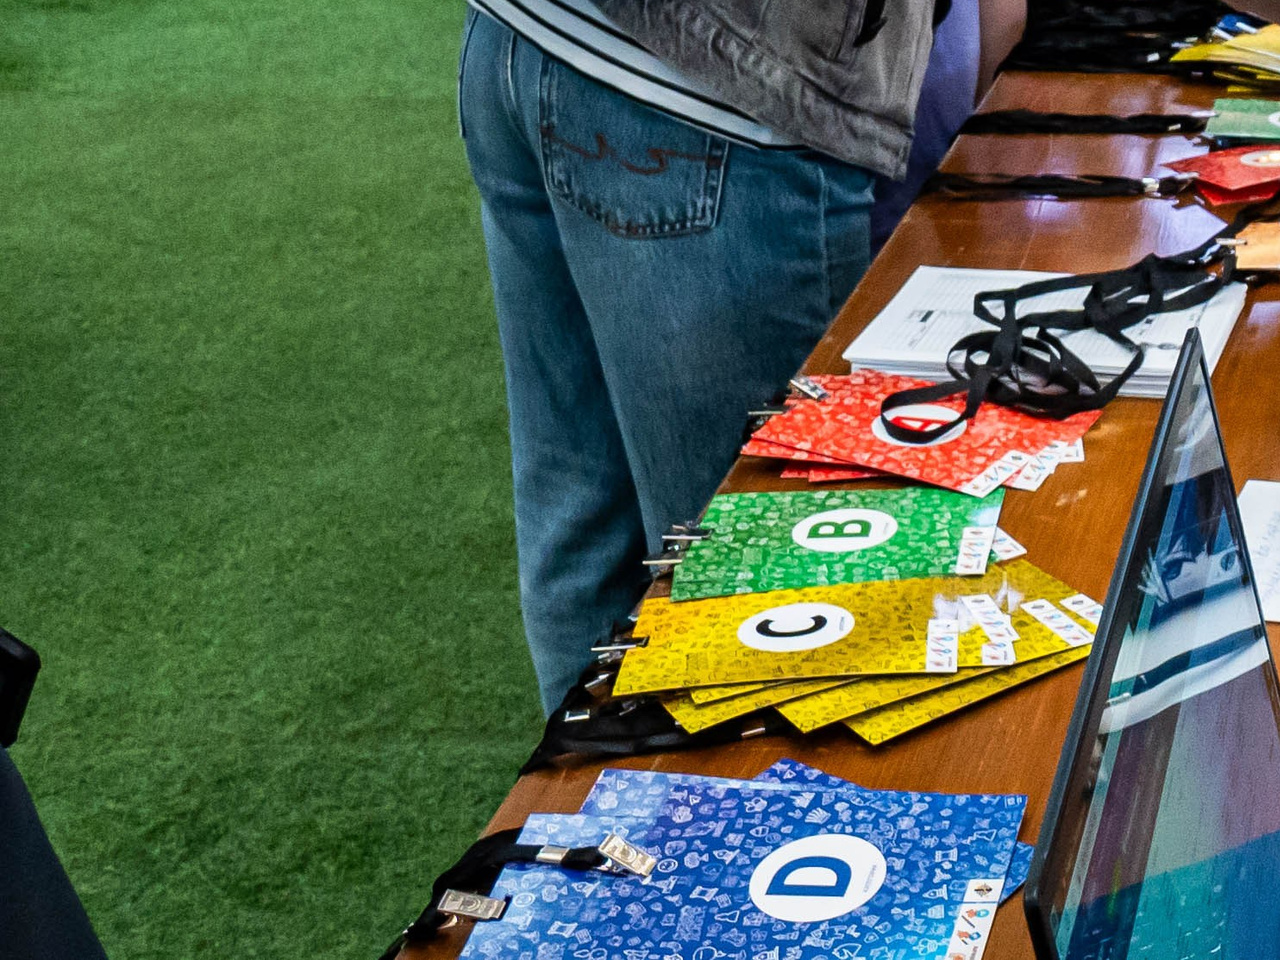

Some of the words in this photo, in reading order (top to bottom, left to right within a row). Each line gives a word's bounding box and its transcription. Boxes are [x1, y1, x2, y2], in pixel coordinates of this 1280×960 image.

[806, 519, 872, 539] B
[755, 614, 828, 639] C
[764, 855, 852, 898] D
